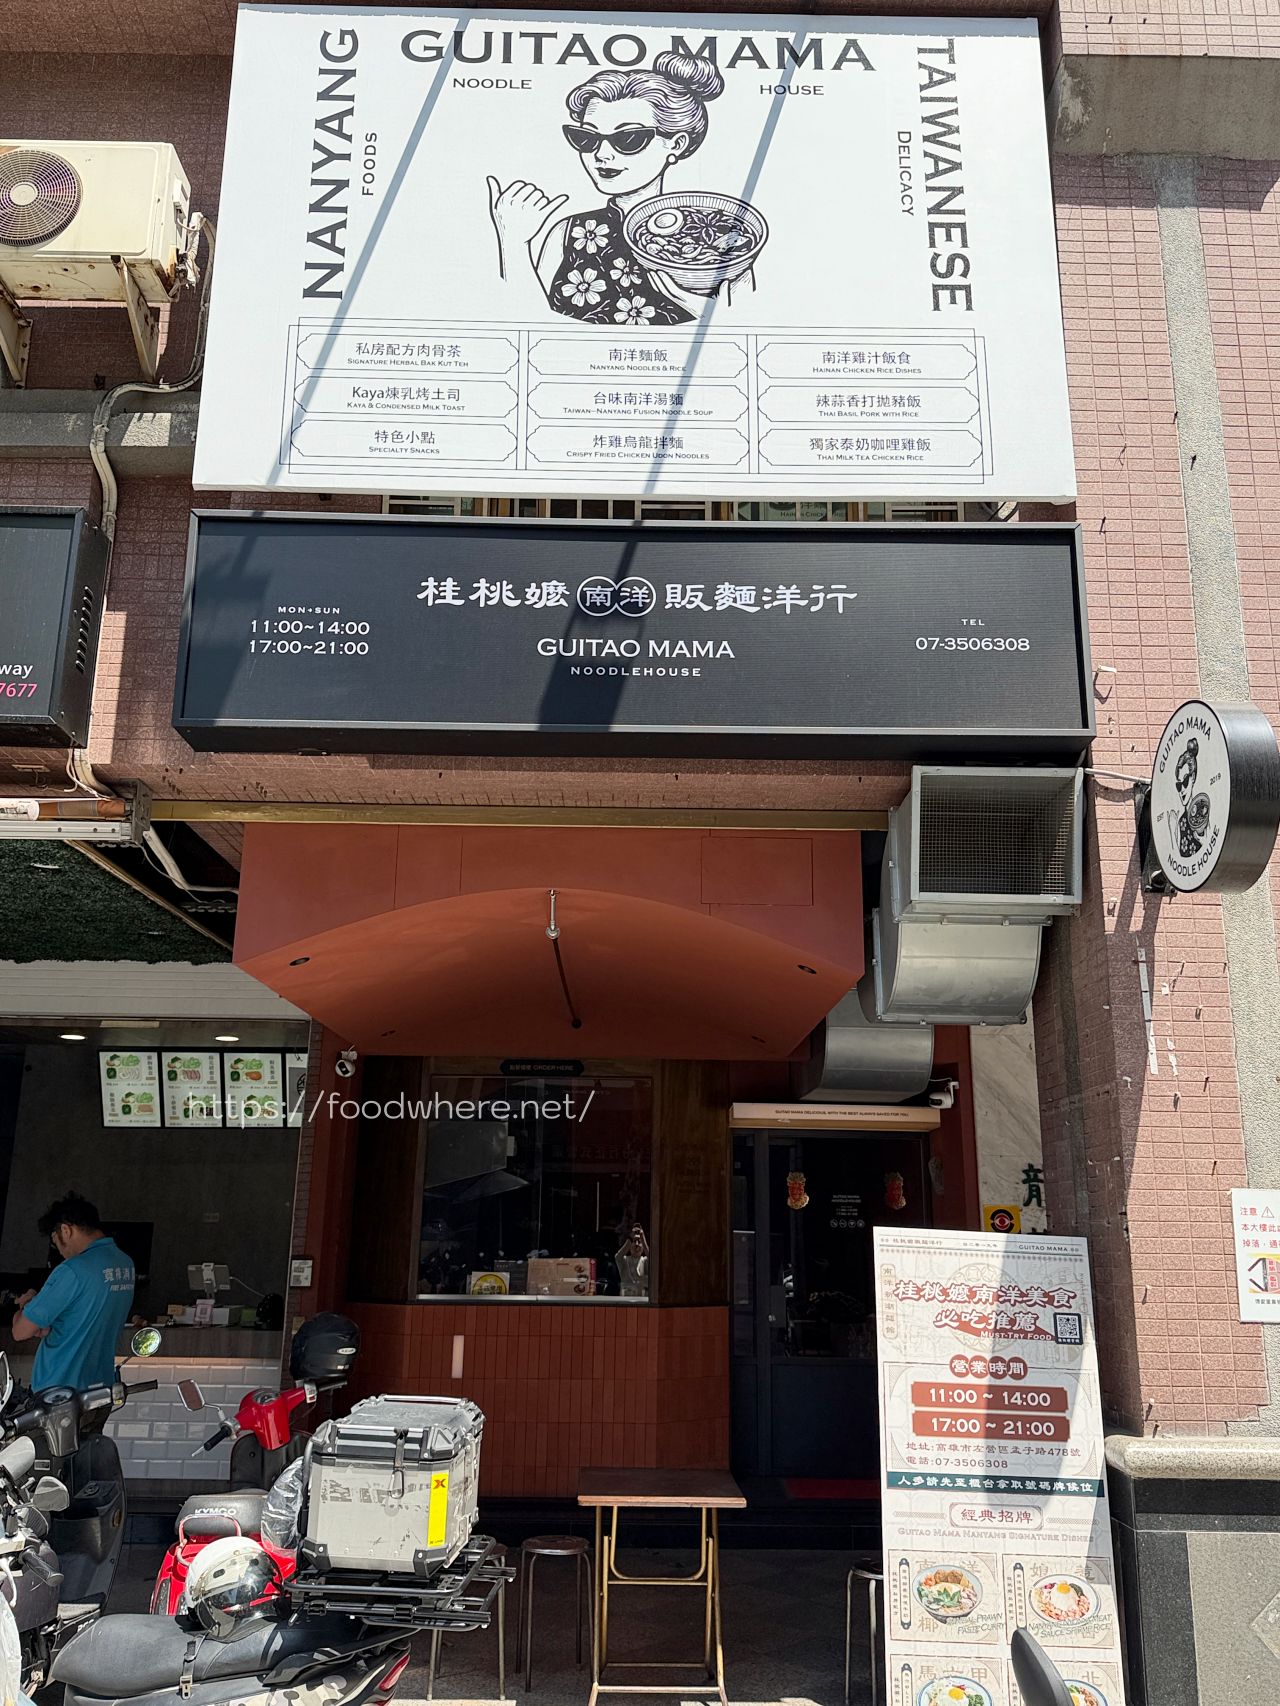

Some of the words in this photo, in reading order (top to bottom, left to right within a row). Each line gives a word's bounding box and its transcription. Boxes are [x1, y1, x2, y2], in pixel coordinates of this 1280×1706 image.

[400, 29, 647, 67] GUITAO
[670, 35, 877, 71] MAMA
[453, 78, 532, 90] NOODLE
[759, 84, 824, 96] HOUSE
[302, 28, 359, 300] NANYANG
[362, 132, 378, 196] FOODS
[897, 130, 915, 216] DELICACY
[917, 38, 974, 312] TAIWANESE
[355, 342, 462, 359] 私房配方肉骨茶
[593, 391, 684, 407] 台味南洋湯麵
[374, 429, 435, 444] 特色小點
[582, 585, 650, 607] 南洋
[664, 581, 858, 615] 販麵洋行
[250, 619, 370, 636] 11:00~14:00
[249, 639, 369, 656] 17:00~21:00
[537, 637, 641, 659] GUITAO
[648, 639, 735, 659] MAMA
[915, 637, 1030, 651] 07-3506308
[570, 666, 702, 677] NOODLEHOUSE
[1159, 721, 1185, 774] GUITAO
[1186, 716, 1212, 741] MAMA
[1167, 854, 1197, 877] NOODLE
[1198, 825, 1220, 871] HOUSE
[893, 1279, 1077, 1309] 桂桃嬤南洋美食
[952, 1359, 1024, 1376] 營業時間
[929, 1388, 977, 1404] 11:00
[1002, 1391, 1051, 1406] 14:00
[931, 1417, 980, 1433] 17:00
[1003, 1420, 1055, 1436] 21:00
[960, 1508, 1033, 1524] 經典招牌
